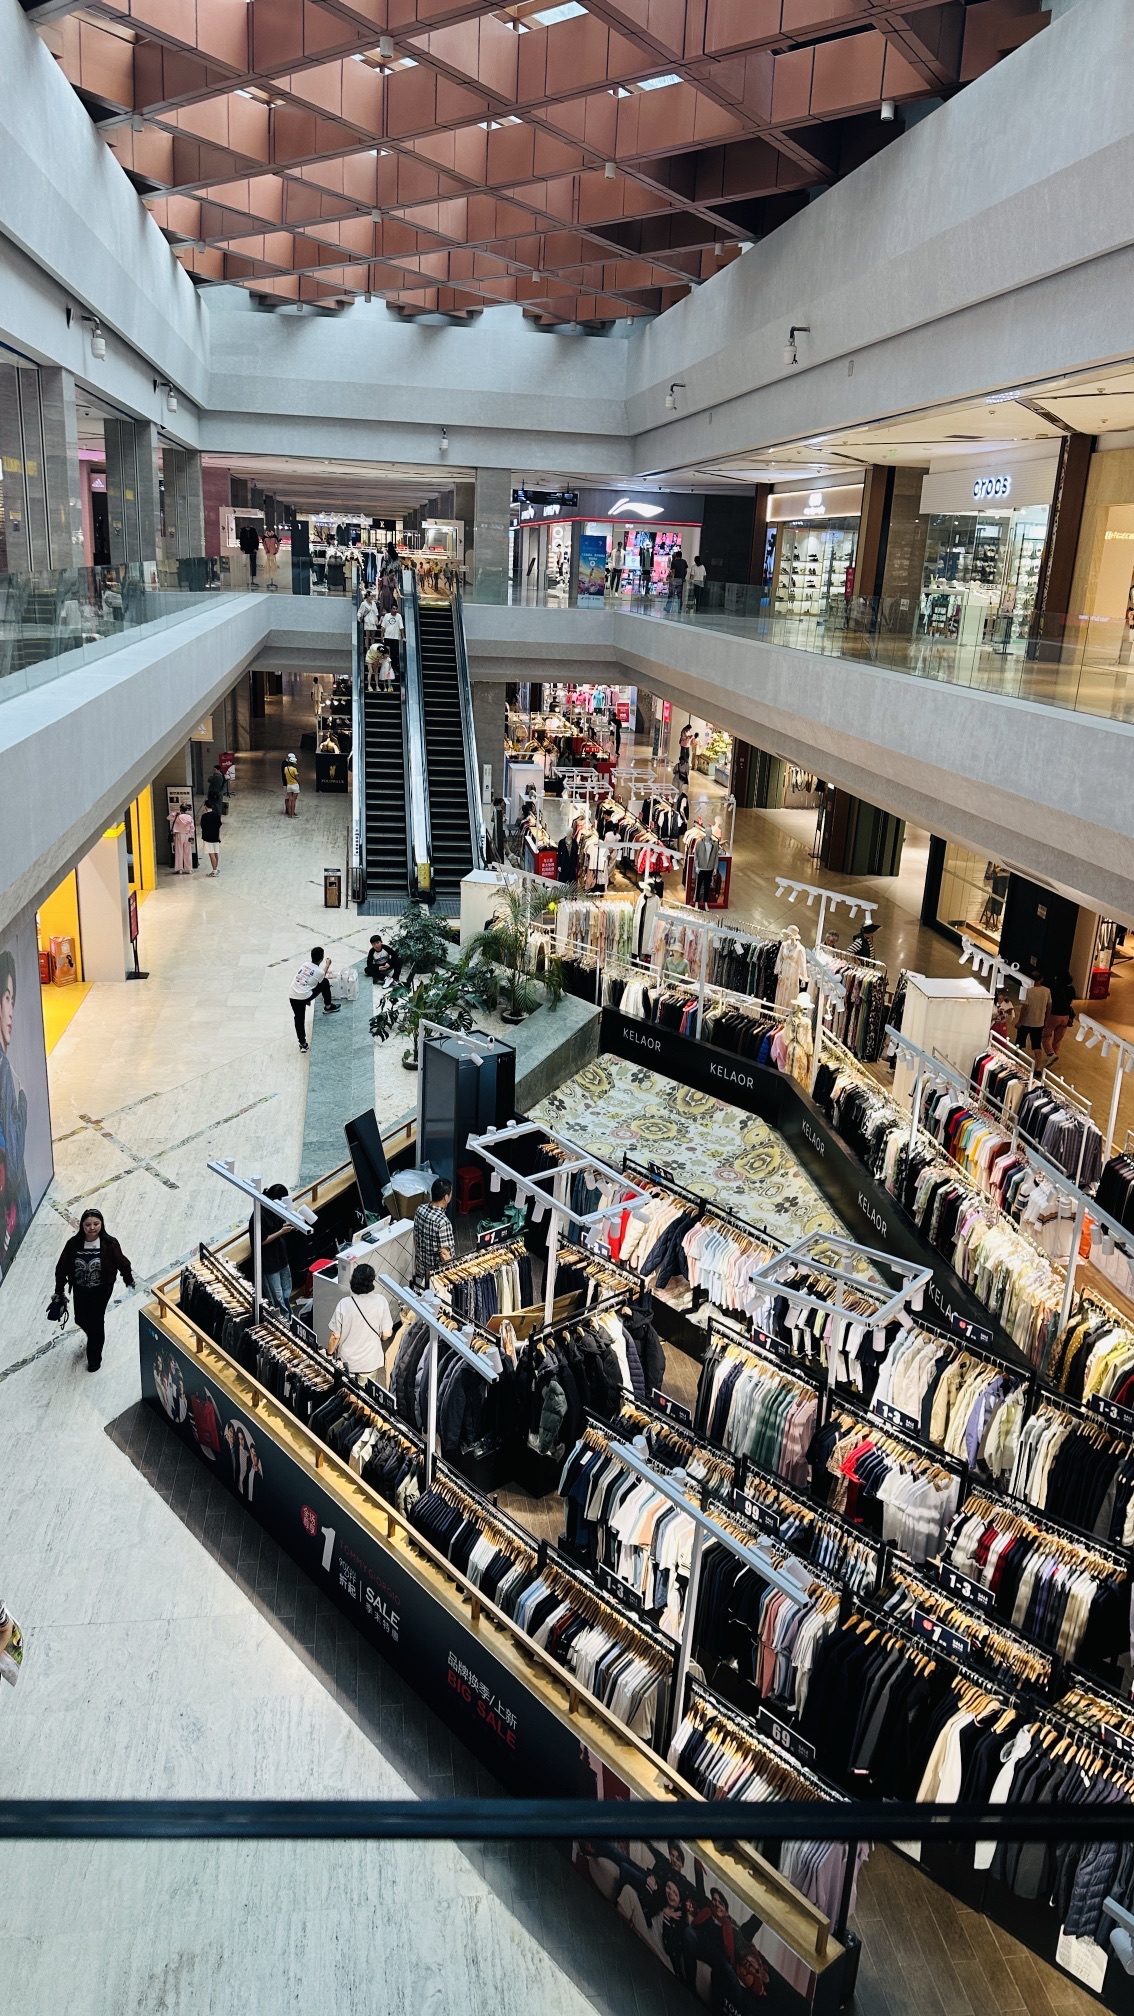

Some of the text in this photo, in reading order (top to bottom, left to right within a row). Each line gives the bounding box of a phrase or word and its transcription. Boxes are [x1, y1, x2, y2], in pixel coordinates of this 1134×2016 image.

[973, 476, 1010, 498] crocs
[622, 1027, 662, 1052] KELAOR
[710, 1062, 754, 1090] KELAOR
[801, 1118, 826, 1157] KELAOR
[857, 1190, 888, 1238] KELAOR
[744, 1500, 760, 1521] 99
[320, 1525, 336, 1573] 1
[606, 1575, 624, 1599] 1-3
[949, 1574, 972, 1597] 1-3
[365, 1586, 401, 1631] SALE
[447, 1669, 517, 1750] BIG SALE
[772, 1723, 791, 1748] 69
